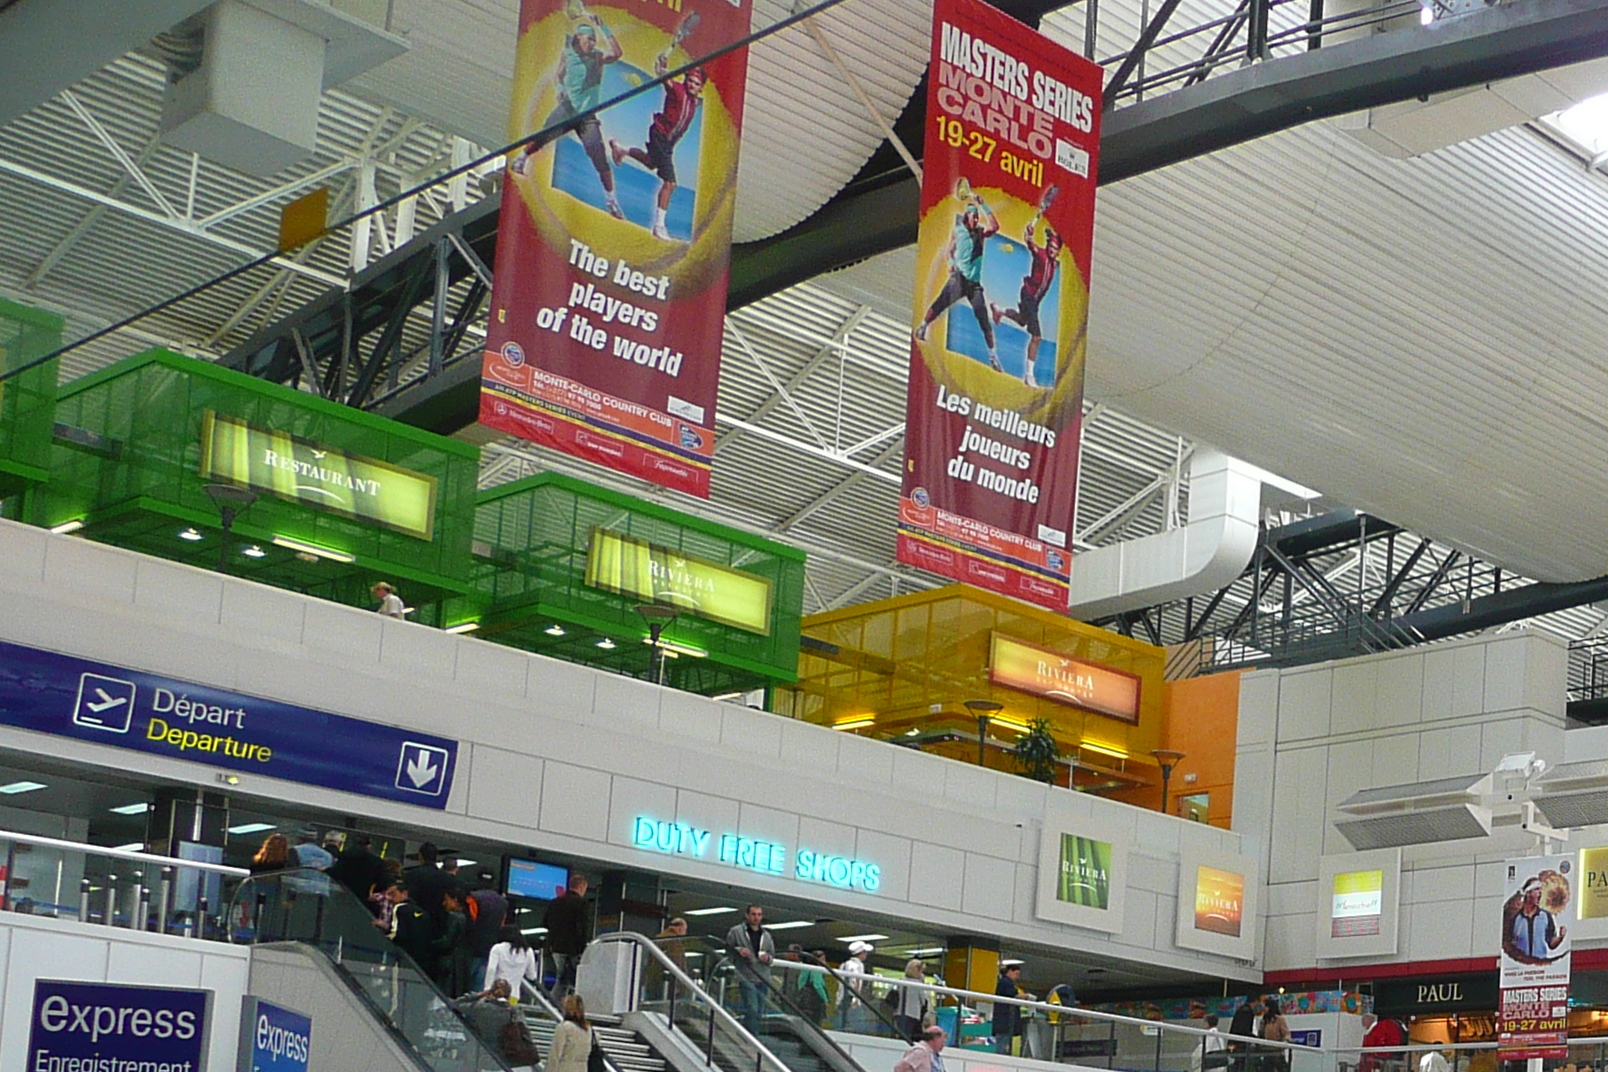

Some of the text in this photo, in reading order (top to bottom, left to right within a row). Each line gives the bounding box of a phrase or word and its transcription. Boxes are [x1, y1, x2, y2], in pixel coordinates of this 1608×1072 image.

[938, 60, 1055, 138] MONTE
[940, 21, 1093, 133] MASTERS SERIES
[937, 86, 1053, 159] CARLO
[936, 115, 1044, 187] 19-27 avril
[569, 238, 670, 300] The best
[568, 282, 659, 332] players
[536, 307, 683, 377] of the world
[534, 370, 601, 402] MONTE-CARLO
[603, 396, 648, 418] COUNTRY
[649, 412, 672, 427] CLUB
[936, 384, 1057, 448] Les meilleurs
[958, 425, 1032, 470] joueurs
[264, 449, 381, 496] RESTAURANT
[947, 455, 1039, 504] du monde
[989, 528, 1025, 546] COUNTRY
[1024, 539, 1042, 552] CLUB
[649, 560, 715, 593] RIVIERA
[1037, 660, 1094, 690] RIVIERA
[152, 688, 247, 729] Départ
[147, 718, 273, 763] Departure
[633, 816, 881, 892] DUTY FREE SHOPS
[1062, 859, 1107, 881] RIVIERA
[1199, 893, 1238, 912] RIVIERA
[1417, 983, 1463, 1003] PAUL
[1503, 986, 1567, 1004] MASTERS SERIES
[1503, 1001, 1550, 1012] MONTE
[1503, 1009, 1550, 1020] CARLO
[40, 994, 197, 1043] express
[256, 1014, 309, 1064] express
[1503, 1018, 1566, 1032] 19-27 avril
